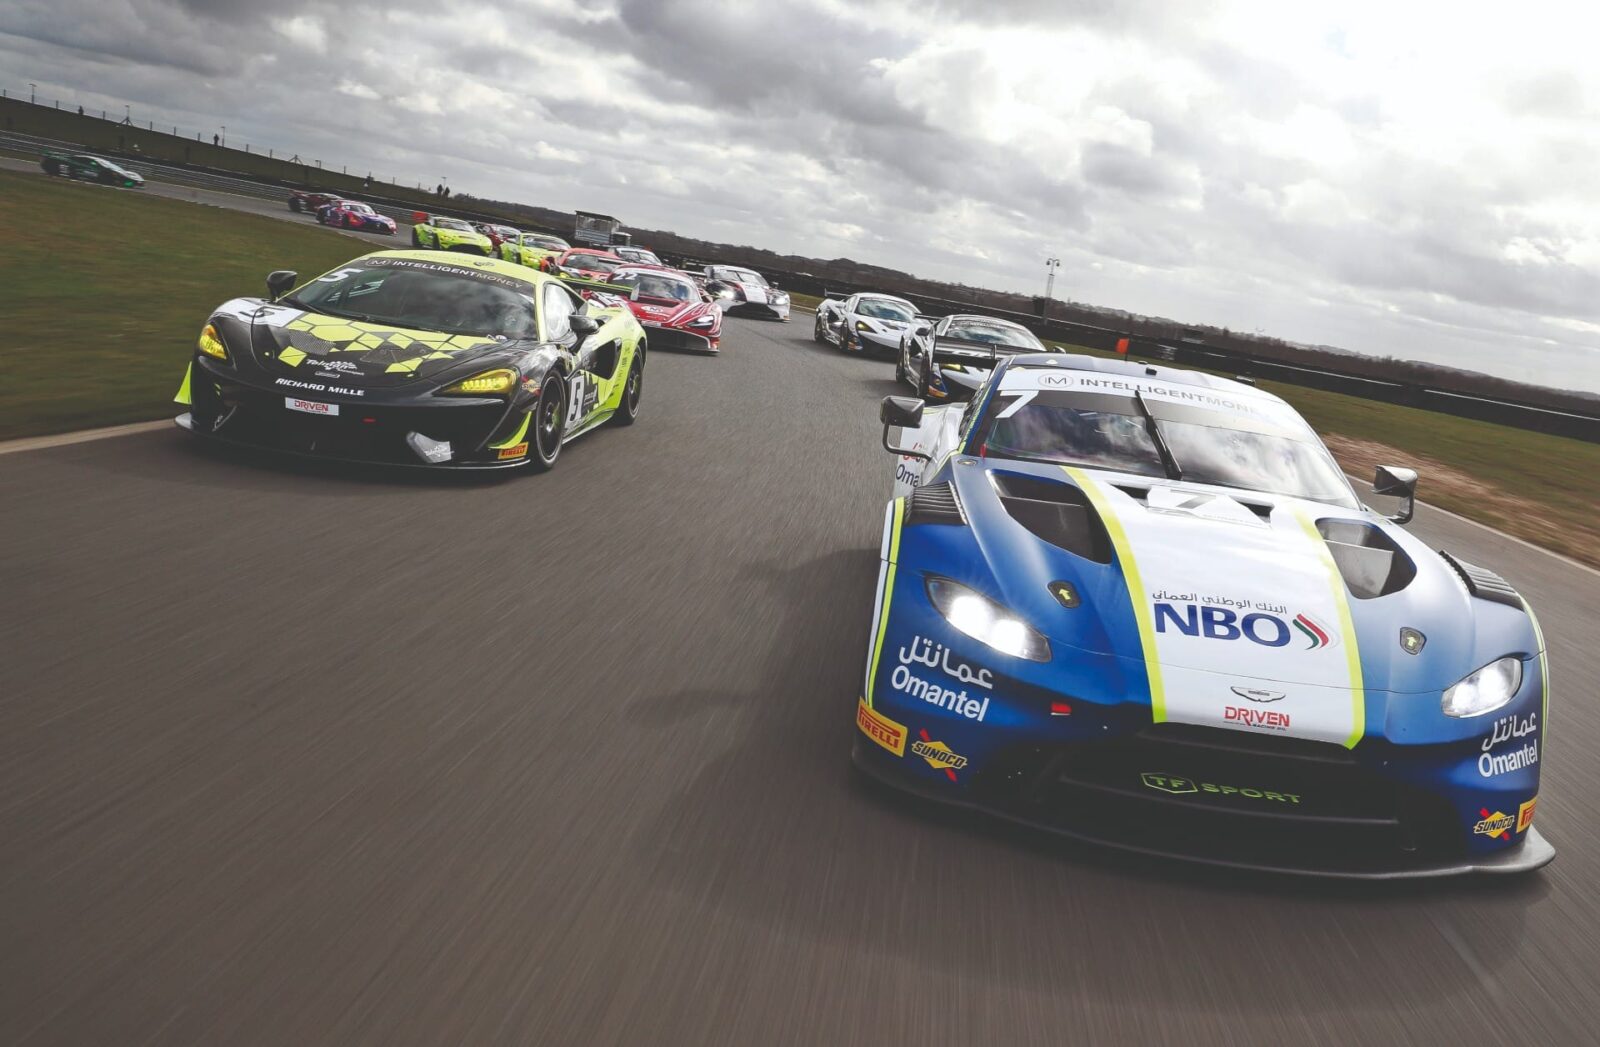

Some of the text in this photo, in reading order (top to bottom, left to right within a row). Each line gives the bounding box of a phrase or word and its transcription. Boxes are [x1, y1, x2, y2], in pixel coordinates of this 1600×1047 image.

[317, 268, 365, 282] 5
[612, 272, 639, 280] 22
[275, 378, 365, 397] RICHARD MILLE
[570, 381, 581, 421] 5
[294, 400, 329, 412] DRIVEN
[995, 390, 1039, 418] 7
[1152, 590, 1287, 616] البنك الوطني العماني
[1153, 603, 1291, 647] NBO
[900, 636, 993, 689] عمانتل
[892, 665, 989, 722] Omantel
[858, 707, 901, 748] PIRELLI
[1224, 706, 1289, 727] DRIVEN
[1481, 712, 1536, 751] عمانتل
[914, 742, 966, 768] SUNOCO
[1478, 739, 1538, 777] Omantel
[1149, 776, 1300, 803] TF SPORT
[1476, 816, 1513, 832] SUNOCO
